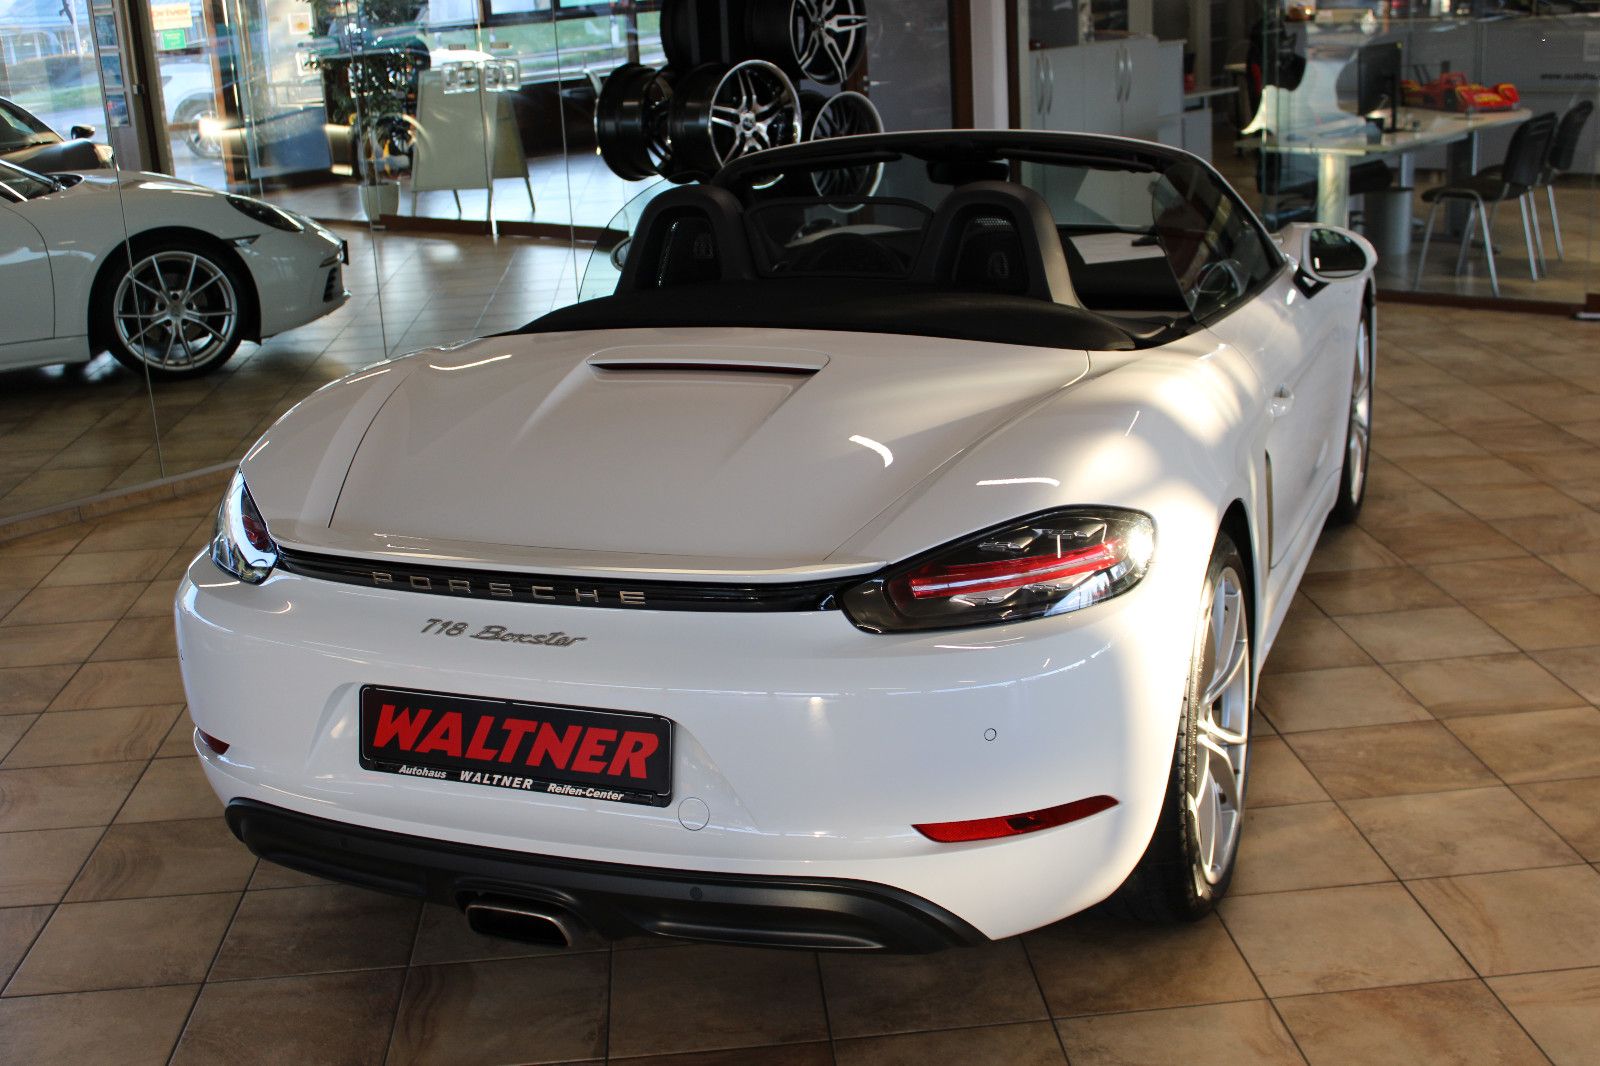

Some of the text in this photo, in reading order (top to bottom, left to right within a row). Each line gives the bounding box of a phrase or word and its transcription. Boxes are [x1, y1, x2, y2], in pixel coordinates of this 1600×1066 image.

[372, 571, 647, 606] PORSCHE
[421, 618, 587, 648] 718 Boxster
[373, 704, 660, 780] WALTNER
[398, 765, 624, 802] Autohaus WALTNER Reifen-Center
